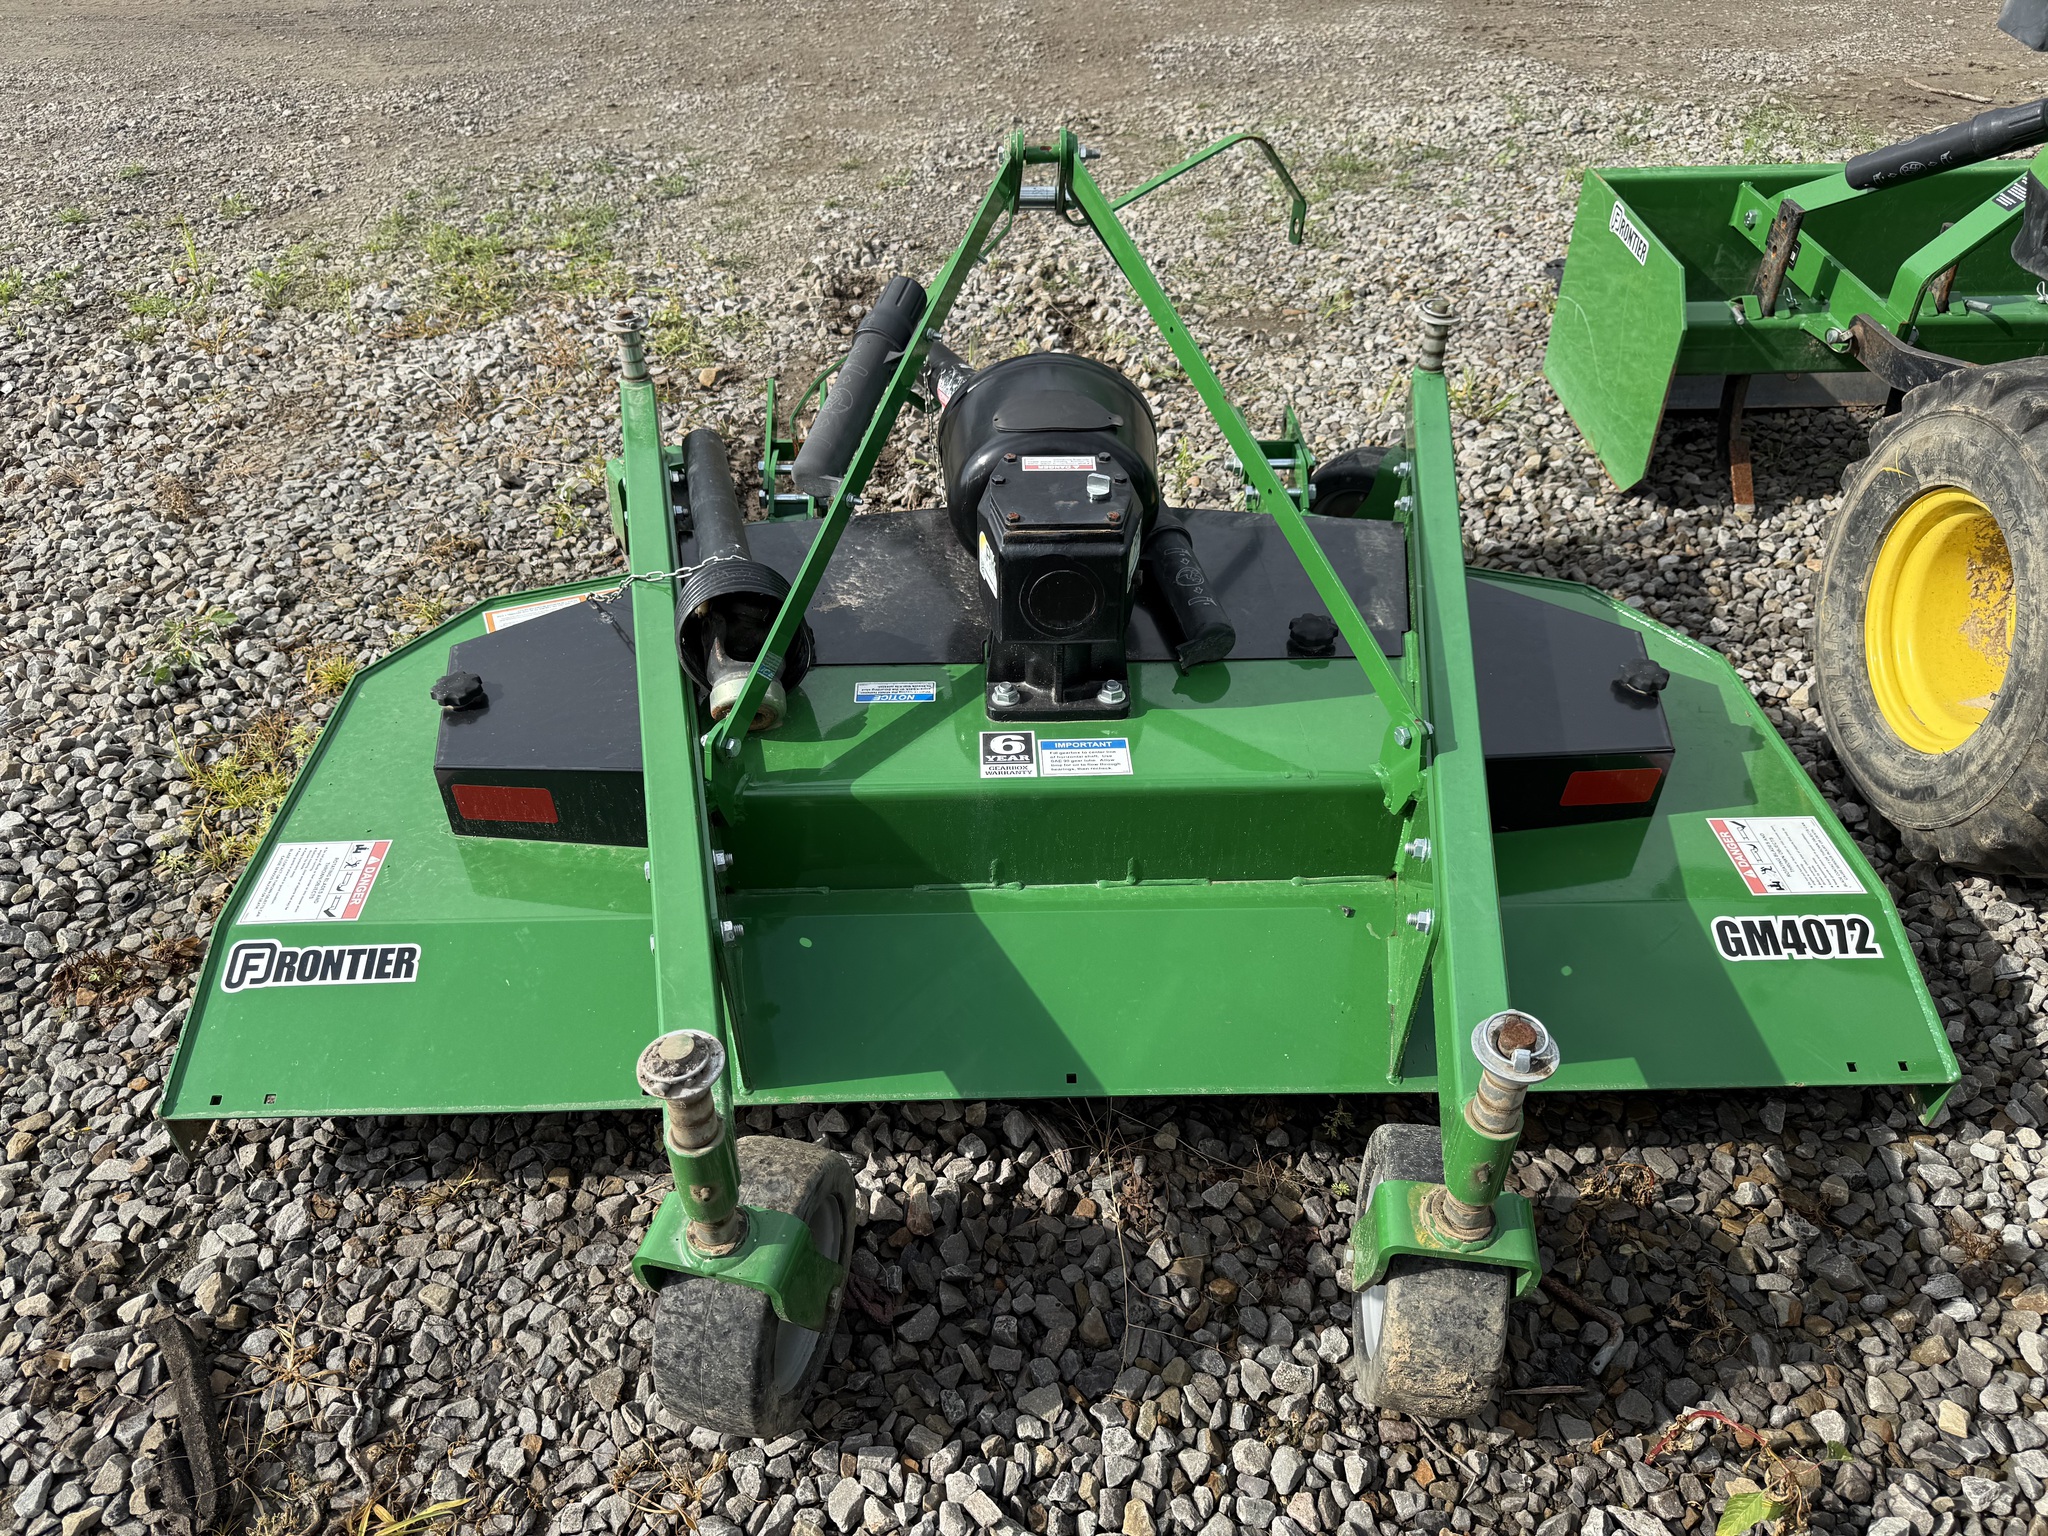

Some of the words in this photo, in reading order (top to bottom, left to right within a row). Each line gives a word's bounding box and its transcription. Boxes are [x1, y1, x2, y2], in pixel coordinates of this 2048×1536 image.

[1611, 203, 1647, 263] FRONTIER
[990, 734, 1026, 755] 6
[1718, 831, 1750, 867] DANGER
[349, 866, 376, 904] DANGER
[1716, 918, 1878, 957] GM4072
[225, 942, 417, 989] FRONTIER
